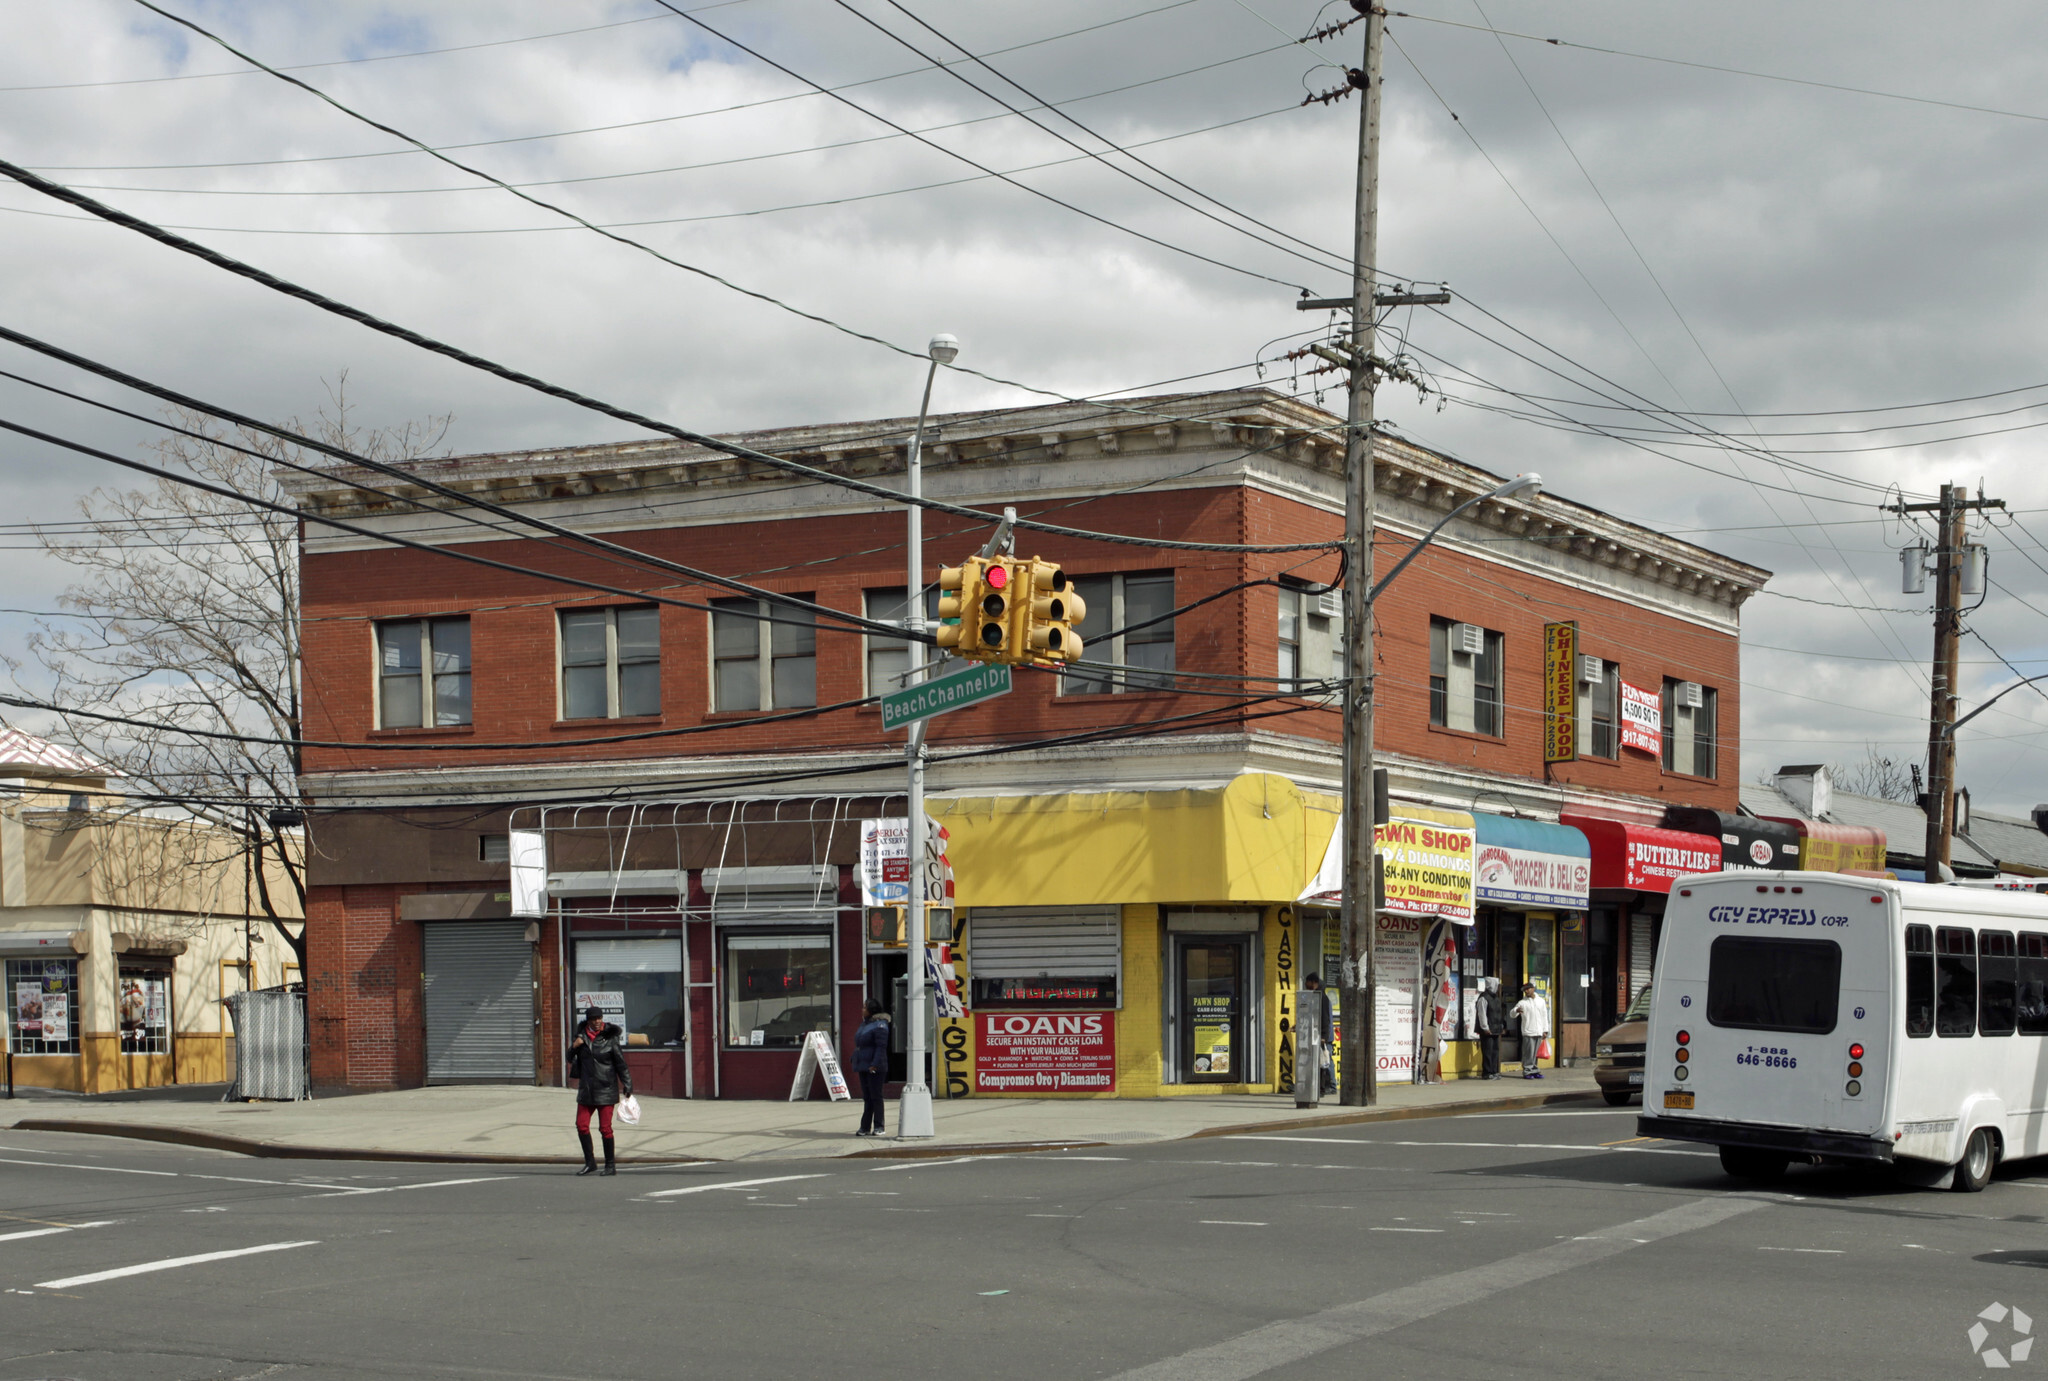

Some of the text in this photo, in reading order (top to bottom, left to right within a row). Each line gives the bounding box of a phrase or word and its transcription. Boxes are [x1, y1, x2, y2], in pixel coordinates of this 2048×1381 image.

[884, 668, 1007, 722] Beach Channel Dr
[1557, 626, 1571, 757] CHINESE FOOD
[1622, 681, 1659, 709] FOR RENT
[1624, 701, 1659, 727] 4,500 SQ FT
[1374, 824, 1471, 853] AWN SHOP
[1395, 848, 1406, 863] &
[1408, 849, 1471, 873] DIAMONDS
[1635, 842, 1711, 871] BUTTERFLIES
[1752, 844, 1771, 861] URBAN
[1385, 865, 1471, 890] SH-ANY CONDITION
[1513, 858, 1573, 892] GROCERY & DELI
[1575, 868, 1587, 880] 24
[1641, 864, 1666, 877] CHINESE
[1399, 886, 1406, 897] y
[1408, 885, 1462, 902] Diamantes
[1385, 897, 1407, 910] Drive,
[1407, 900, 1420, 910] Ph:
[1375, 916, 1419, 931] OANS
[1746, 907, 1816, 926] EXPRESS
[1821, 915, 1849, 927] CORP.
[1277, 906, 1292, 990] CASH
[1193, 997, 1231, 1007] PAWN SHOP
[987, 1015, 1103, 1035] LOANS
[986, 1036, 1103, 1046] SECURE AN INSTANT CASH LOAN
[1278, 993, 1295, 1094] LOANS
[1747, 1045, 1788, 1055] 1-888
[1010, 1046, 1079, 1056] WITH YOUR VALUABLES
[1375, 1056, 1416, 1070] OANS
[1737, 1053, 1797, 1069] 646-8666
[979, 1071, 1035, 1090] Compromos
[1052, 1074, 1060, 1090] y
[1060, 1071, 1111, 1086] Diamantes
